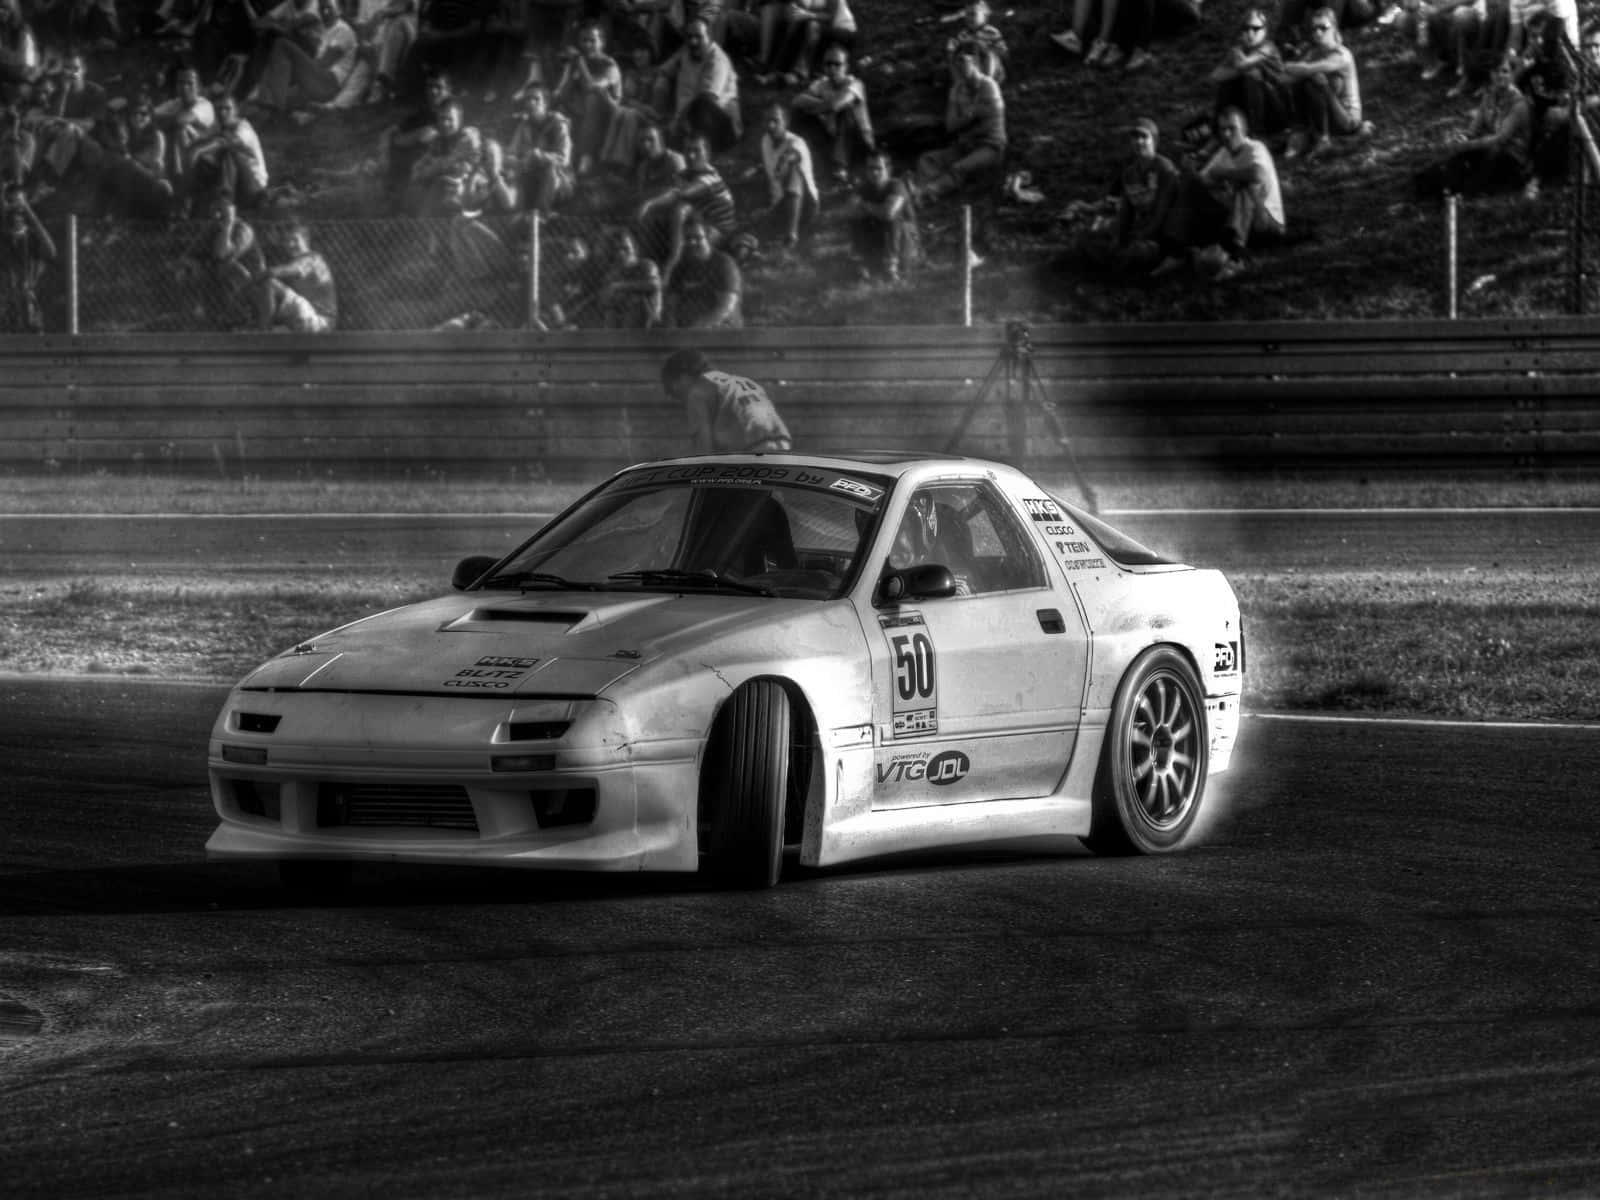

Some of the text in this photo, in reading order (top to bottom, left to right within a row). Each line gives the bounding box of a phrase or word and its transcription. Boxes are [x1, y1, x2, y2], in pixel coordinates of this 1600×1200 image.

[667, 466, 716, 481] CUP
[720, 465, 789, 481] 2009
[793, 471, 824, 486] by
[1023, 498, 1060, 515] HKS
[1045, 526, 1075, 536] CUSCO
[1064, 541, 1090, 553] TEIN
[891, 632, 935, 701] 50
[455, 669, 525, 679] BLITZ
[443, 680, 510, 689] CUSCO
[891, 752, 922, 762] powered
[876, 760, 927, 784] VTG
